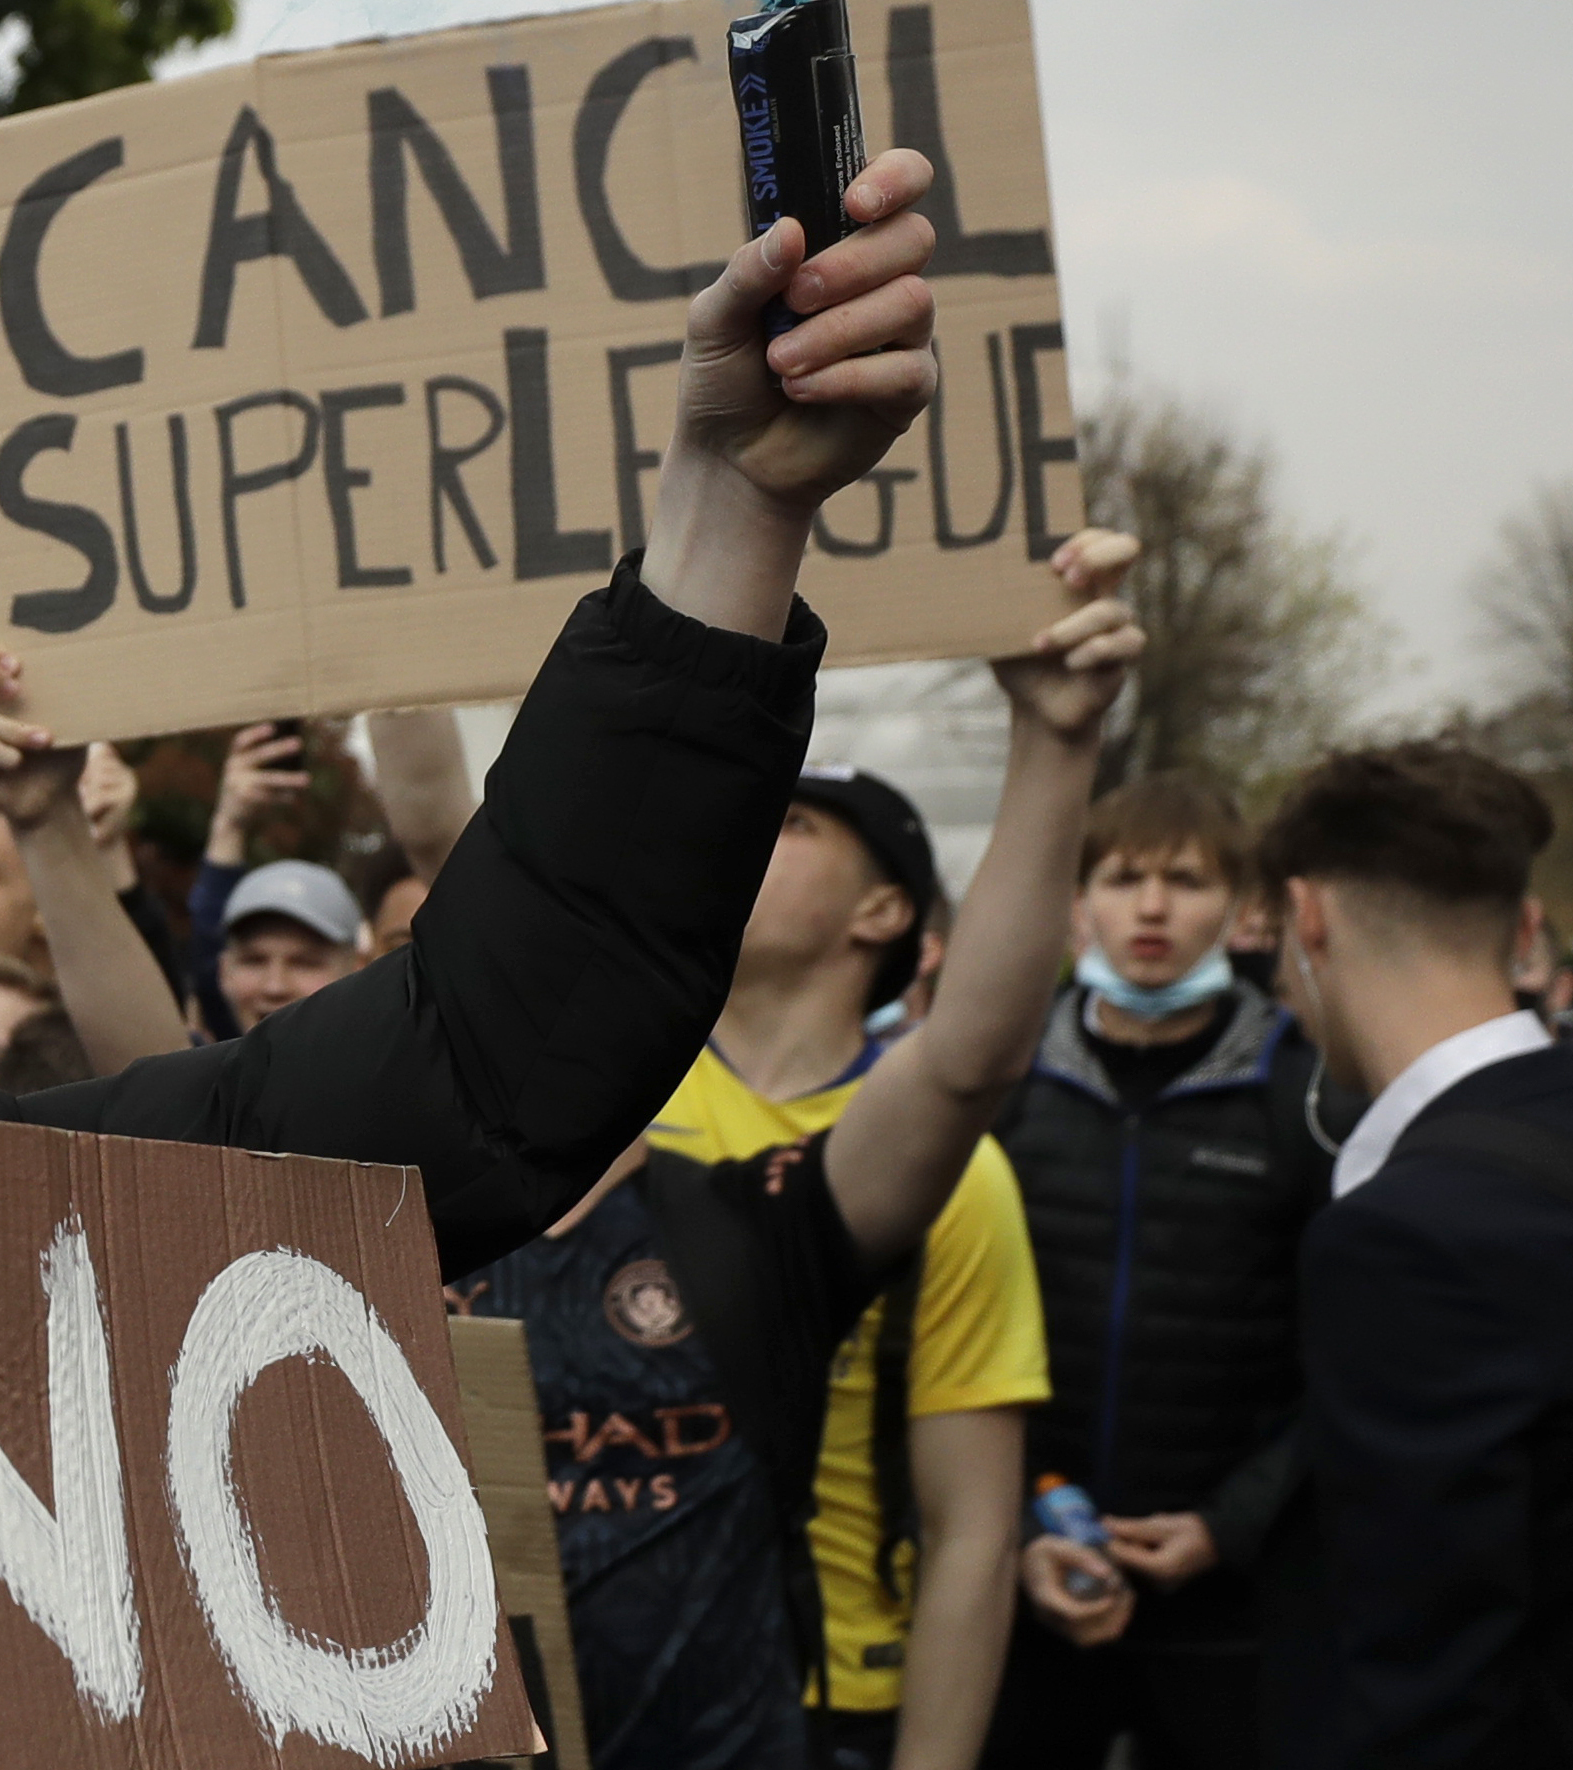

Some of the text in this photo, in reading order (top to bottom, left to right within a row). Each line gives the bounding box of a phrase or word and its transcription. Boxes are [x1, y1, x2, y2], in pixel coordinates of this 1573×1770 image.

[742, 99, 778, 200] SMOKE
[833, 125, 843, 169] Enclosed
[542, 1403, 732, 1462] HAD
[546, 1473, 680, 1513] WAYS
